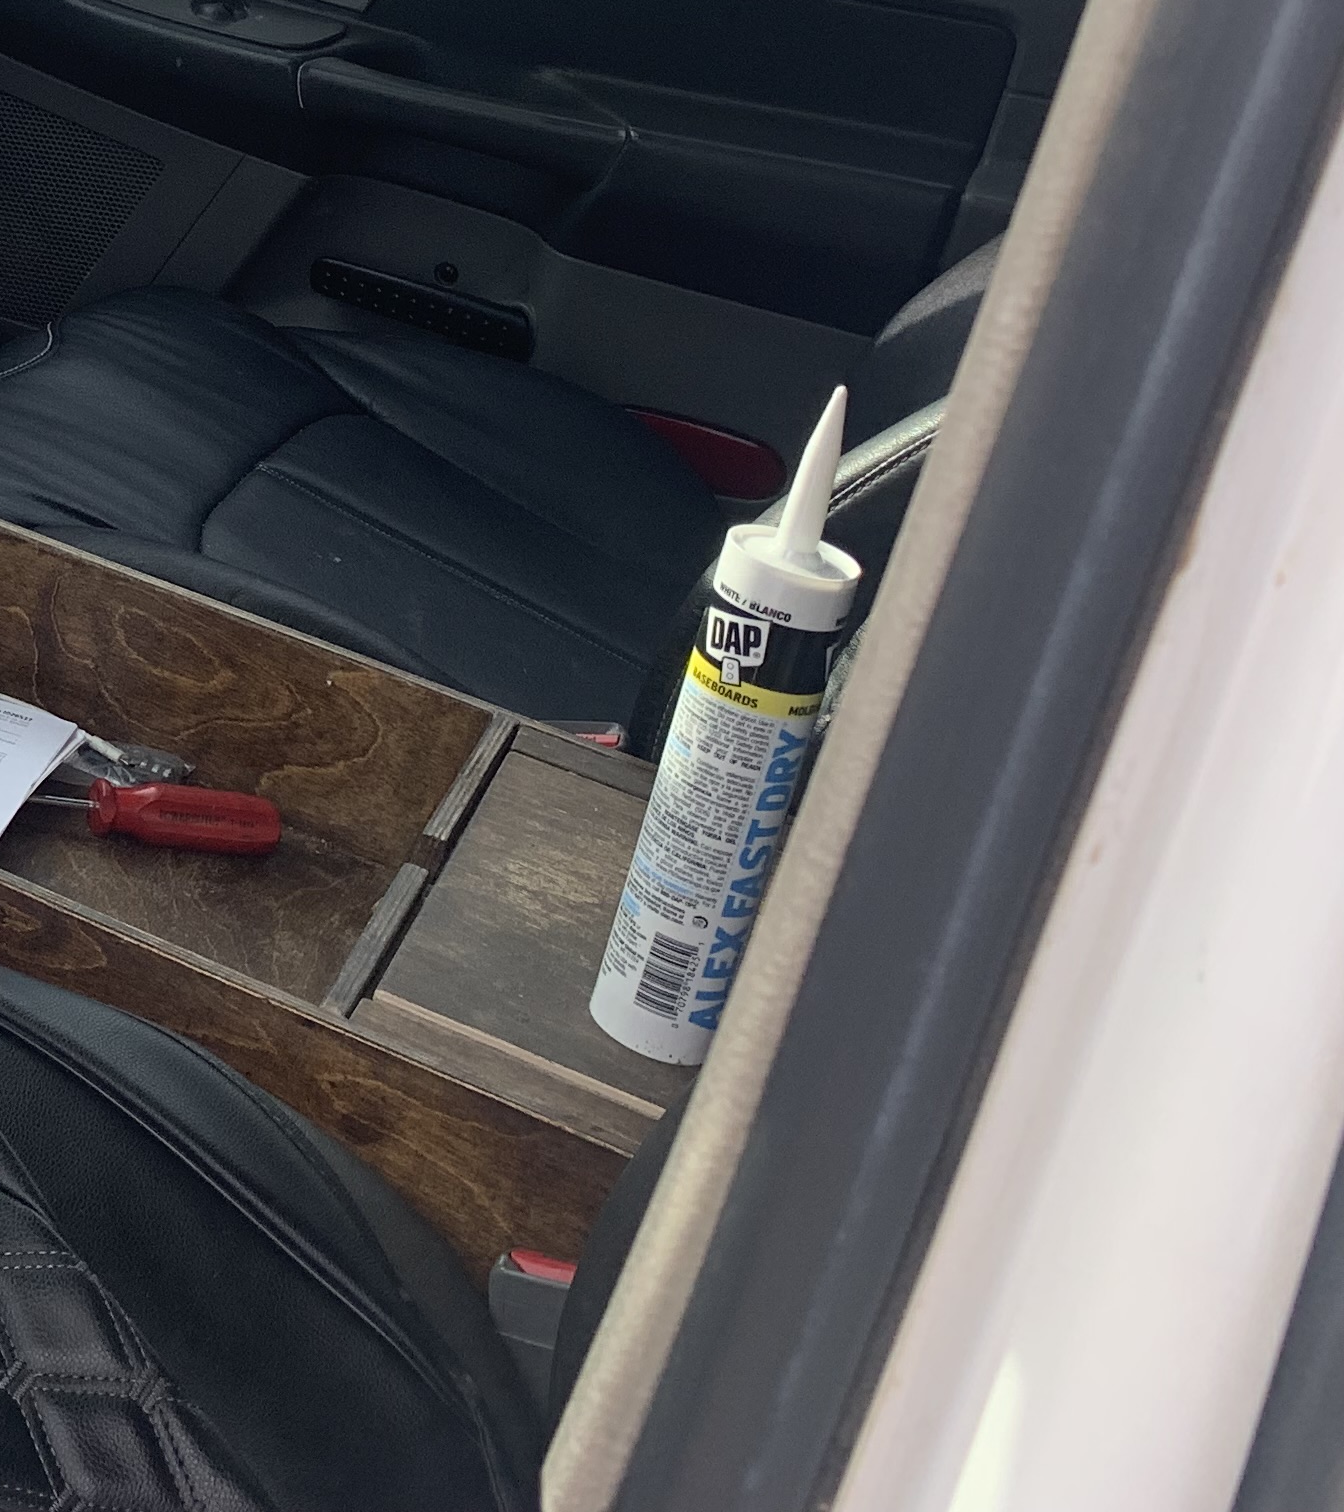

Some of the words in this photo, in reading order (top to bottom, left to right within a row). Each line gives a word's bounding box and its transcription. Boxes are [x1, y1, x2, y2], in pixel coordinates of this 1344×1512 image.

[719, 581, 741, 604] WHITE
[749, 600, 792, 623] BLANCO
[710, 616, 762, 657] DAP
[692, 666, 759, 709] BASEBOARDS
[688, 926, 750, 1030] ALEX
[721, 819, 780, 918] FAST
[756, 729, 806, 812] DRY
